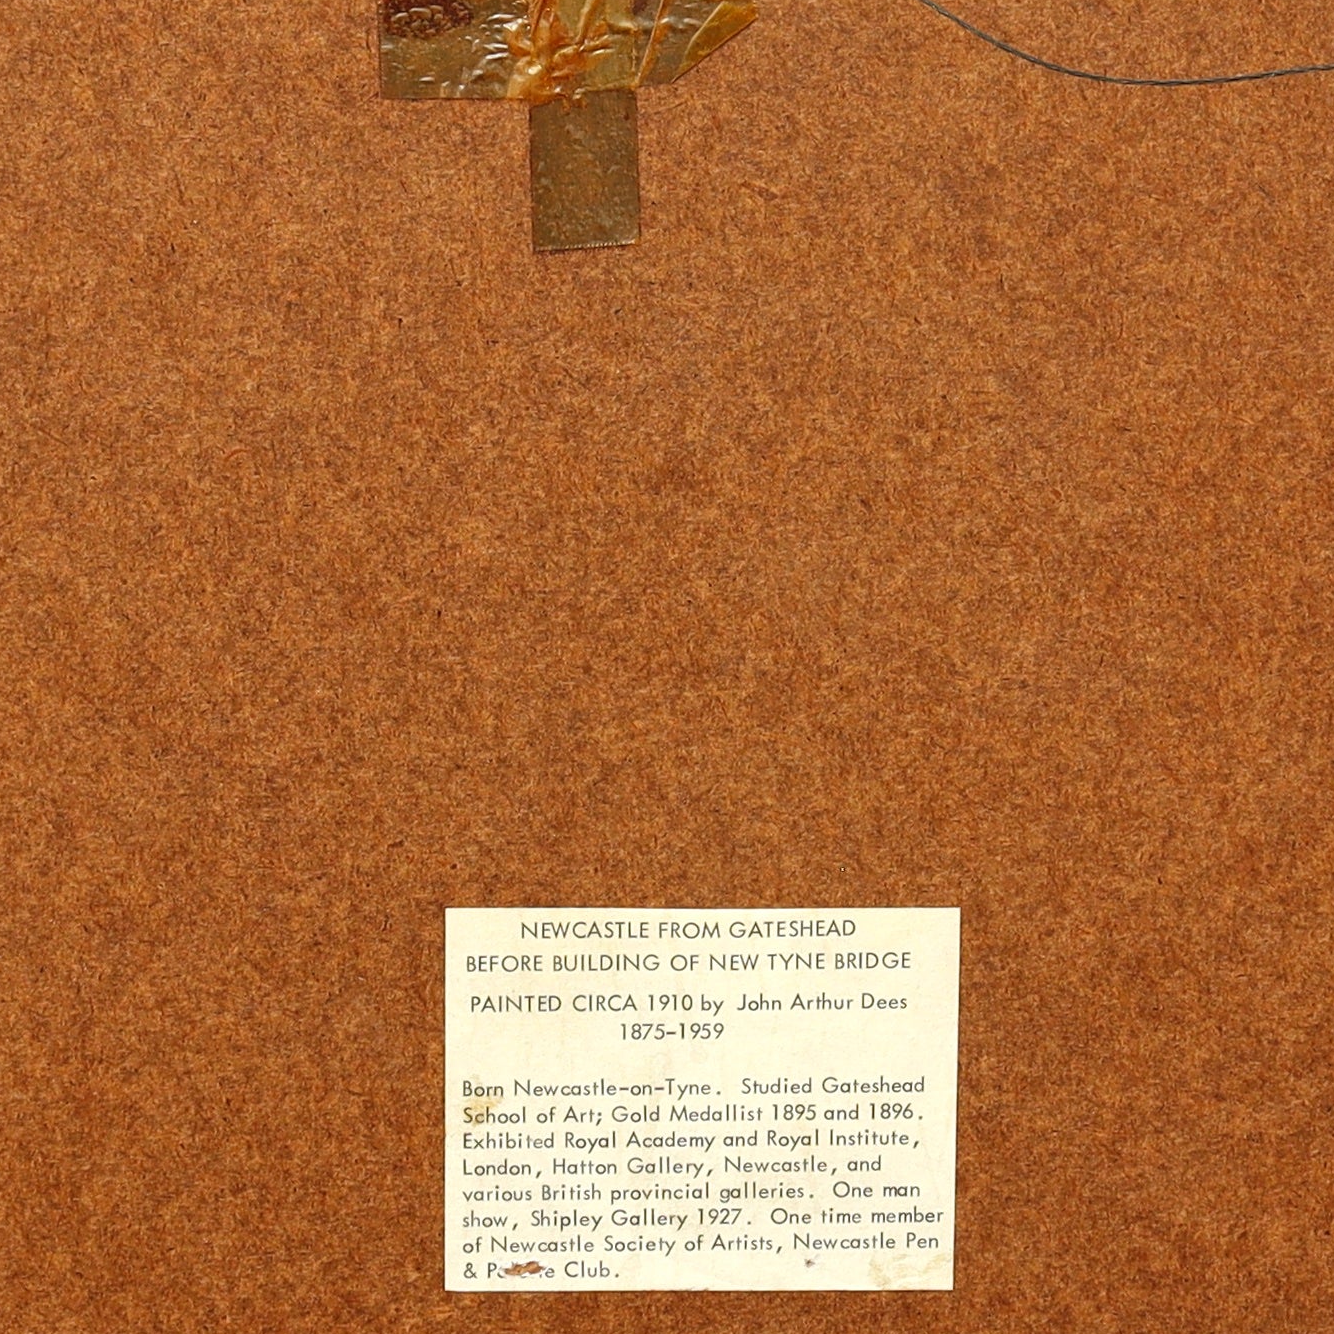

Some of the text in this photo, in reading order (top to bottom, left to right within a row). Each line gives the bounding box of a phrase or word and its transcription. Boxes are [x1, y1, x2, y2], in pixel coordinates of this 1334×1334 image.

[521, 919, 856, 940] NEWCASTLE FROM GATESHEAD
[466, 951, 911, 973] BEFORE BUILDING OF NEW TYNE BRIDGE
[471, 992, 908, 1017] PAINTED CIRCA 1910 by John Arthur Dees
[462, 1075, 925, 1101] Born Newcastle-on-Tyne. Studied Gateshead
[463, 1102, 923, 1126] School of Art; Gold Medallist 1895 and 1896.
[463, 1128, 919, 1154] Exhibited Royal Academy and Royal Institute,
[463, 1154, 882, 1179] London, Hatton Gallery, Newcastle, and
[462, 1180, 920, 1205] various British provincial galleries. One man
[463, 1205, 944, 1232] show, Shipley Gallery 1927. One time member
[462, 1231, 939, 1257] of Newcastle Society of Artists, Newcastle Pen
[463, 1262, 477, 1279] &
[564, 1260, 619, 1278] Club.
